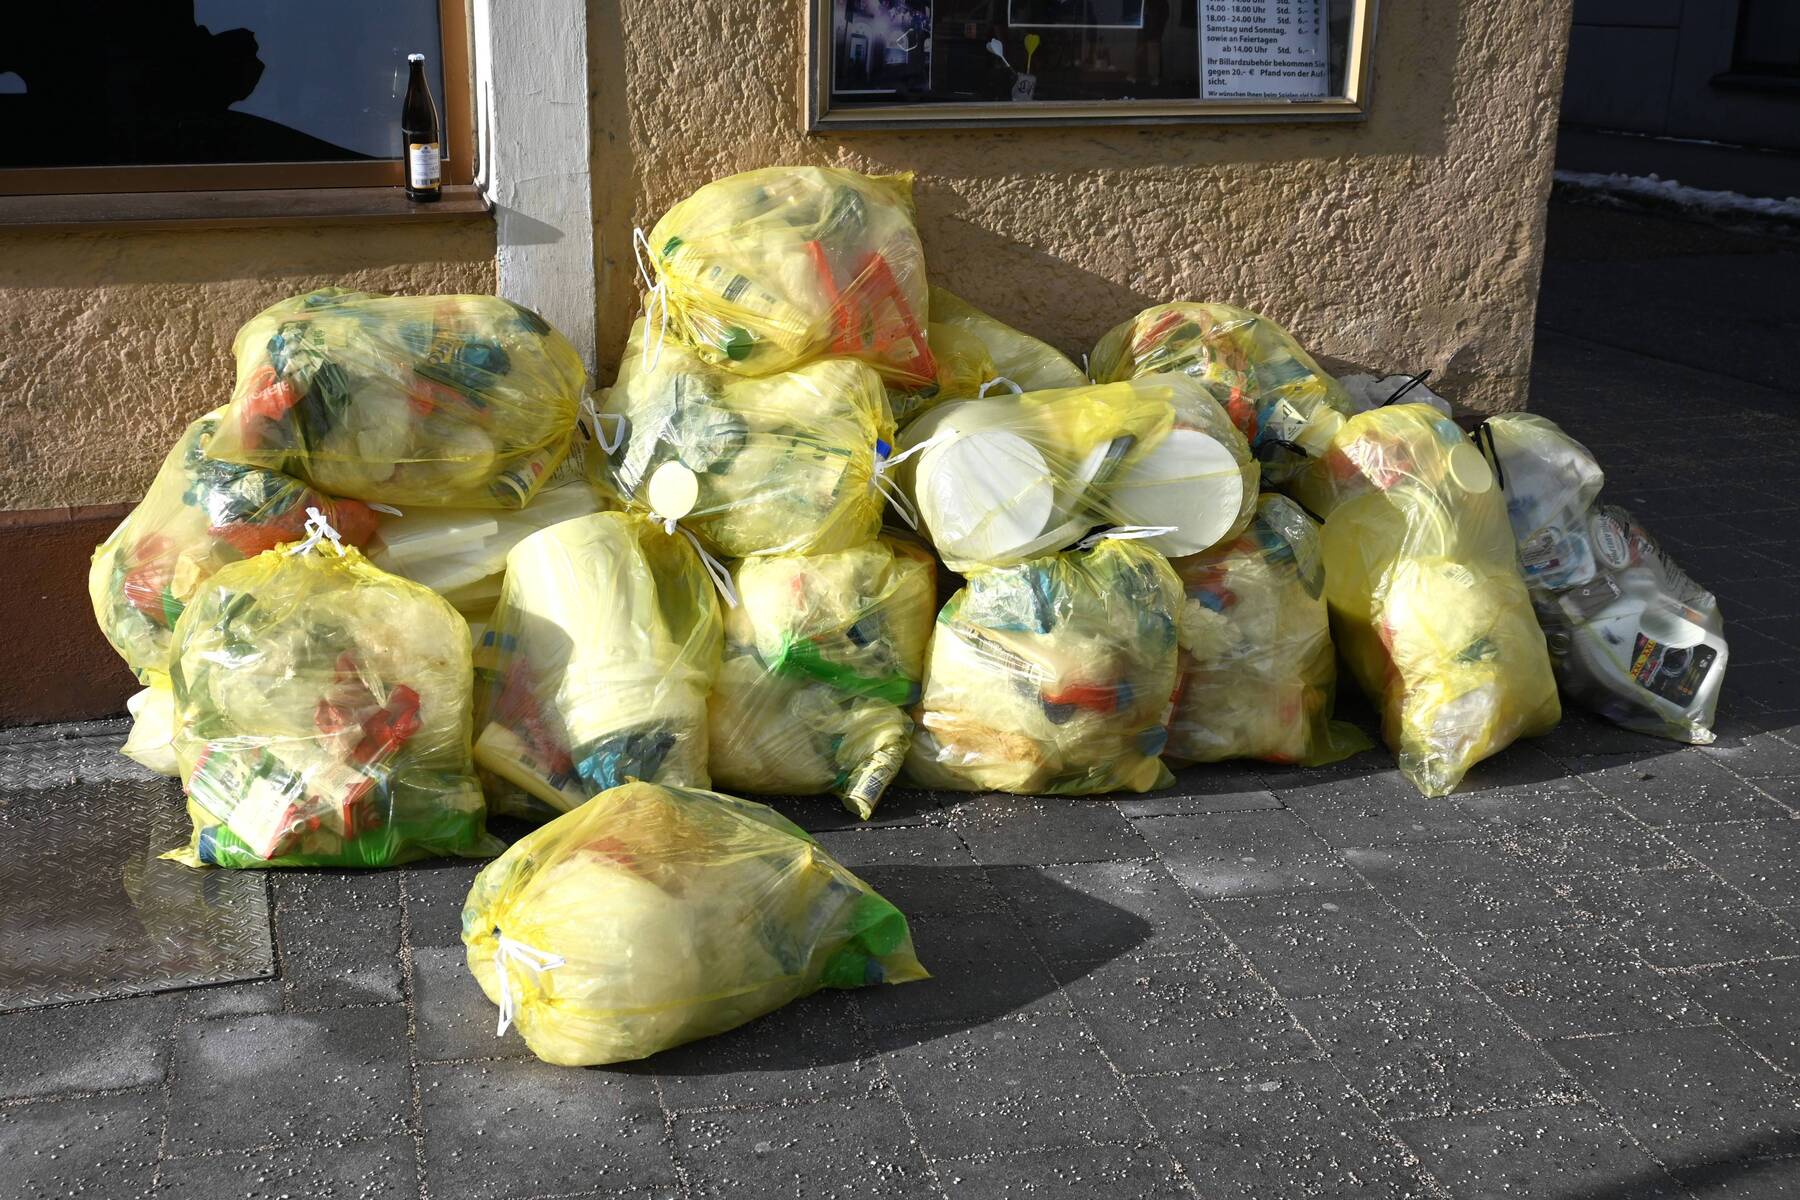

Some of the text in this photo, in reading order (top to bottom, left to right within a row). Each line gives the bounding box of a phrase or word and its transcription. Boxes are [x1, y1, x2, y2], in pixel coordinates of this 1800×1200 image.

[1206, 24, 1238, 34] Samstag
[1240, 35, 1278, 44] Feiertagen
[1208, 57, 1218, 65] Ihr
[1219, 58, 1272, 66] Billardzubehör
[1274, 59, 1313, 68] bekommen
[1208, 77, 1227, 86] sicht.
